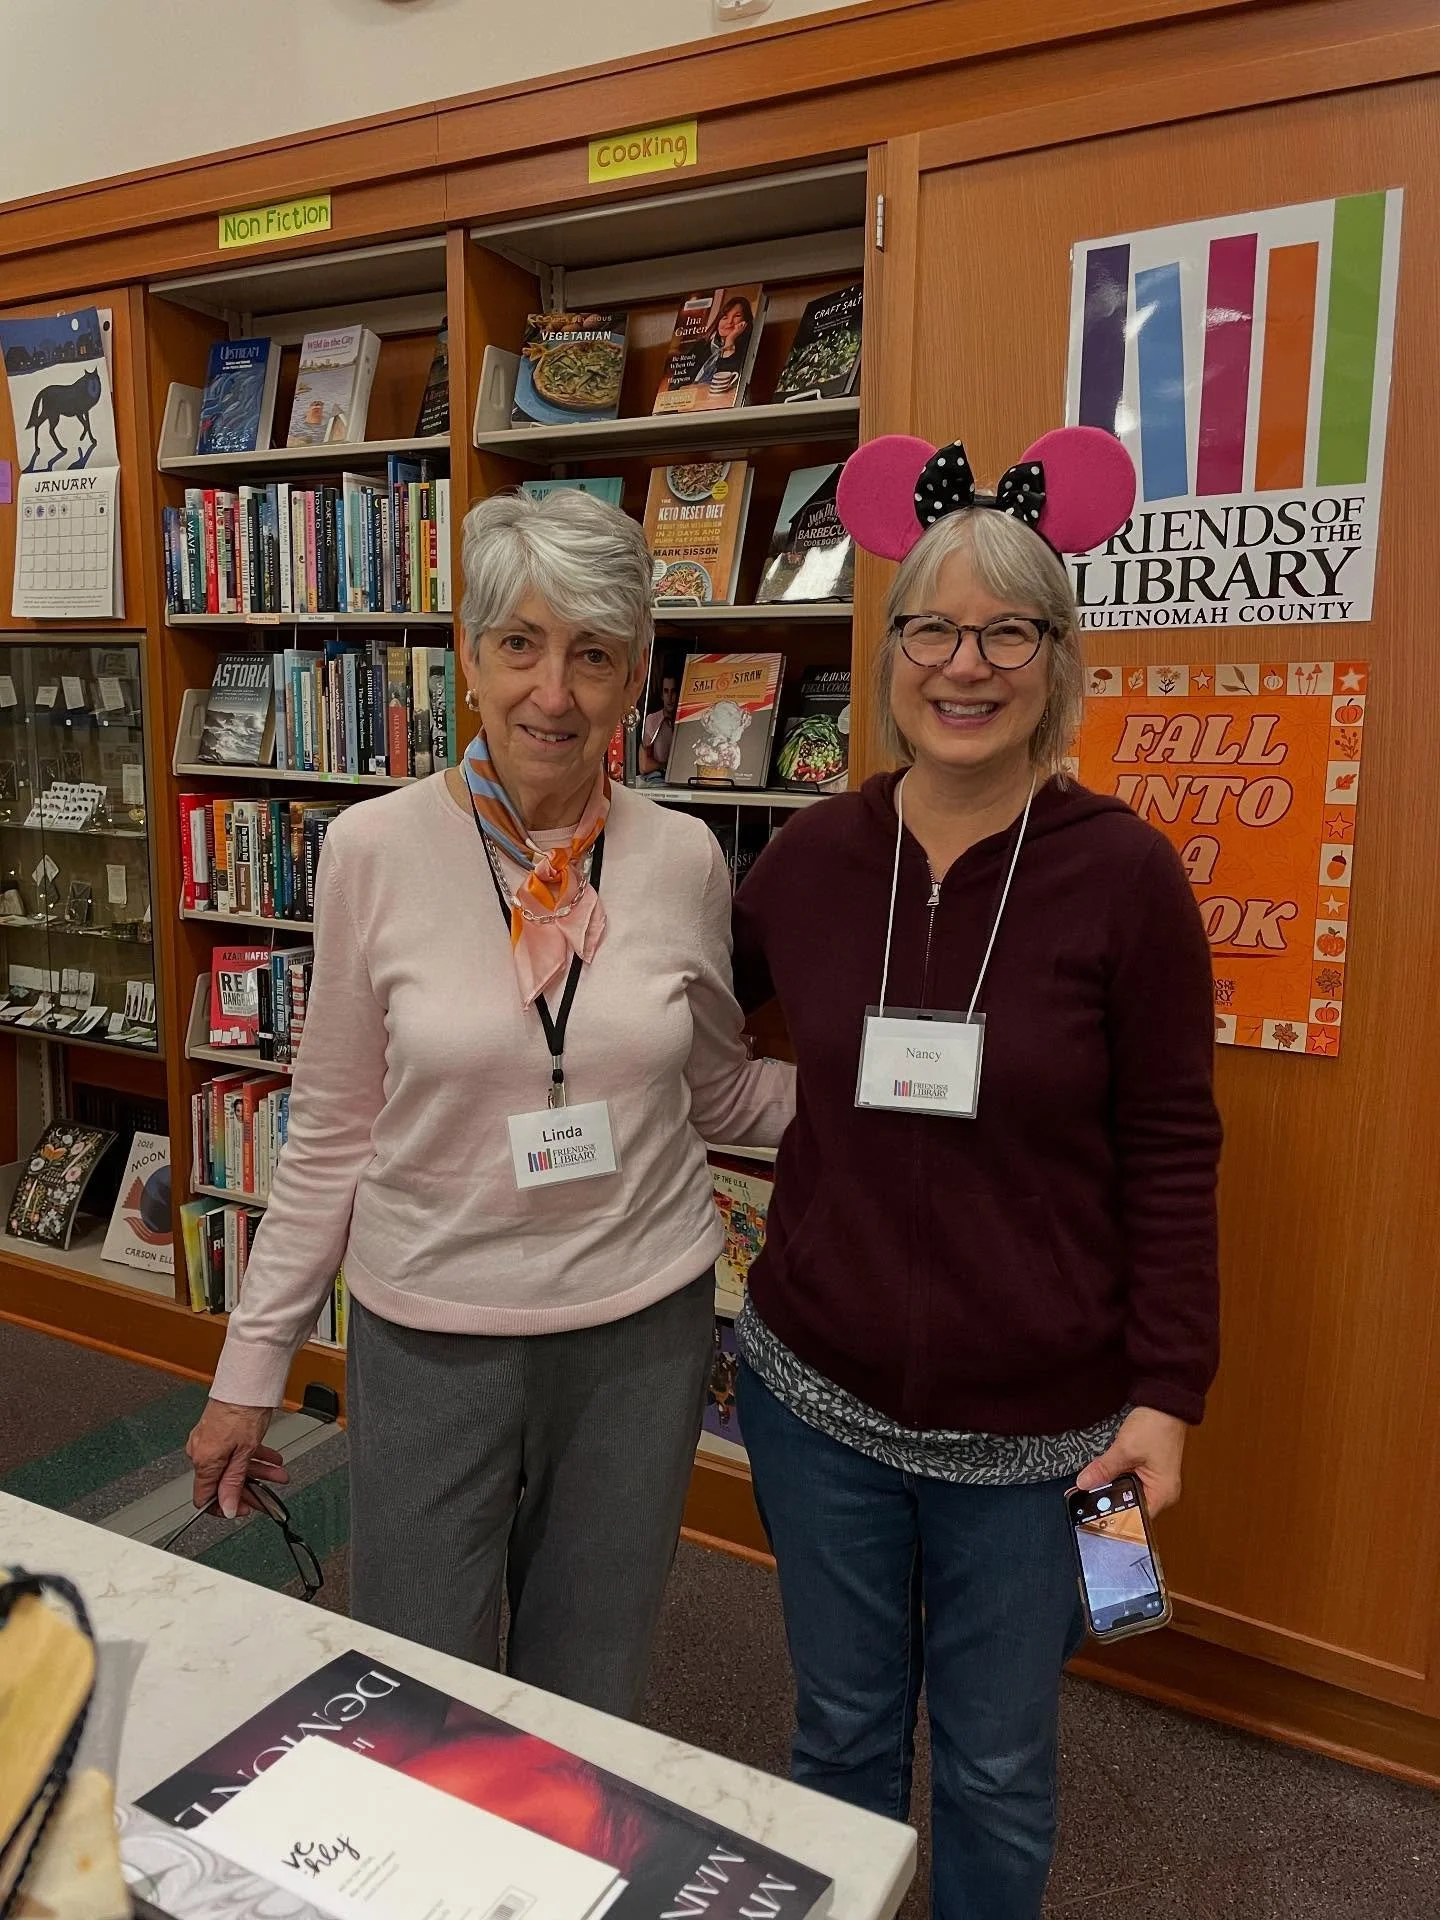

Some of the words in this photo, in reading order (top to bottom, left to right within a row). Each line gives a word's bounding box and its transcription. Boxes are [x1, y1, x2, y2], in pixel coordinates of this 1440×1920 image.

[596, 132, 688, 170] Cooking
[223, 212, 264, 242] Non
[266, 203, 330, 237] Fiction
[814, 303, 842, 320] CRAFT
[686, 316, 702, 326] Ina
[541, 331, 611, 341] VEGETARIAN
[675, 325, 709, 337] Garten
[35, 477, 98, 493] JANUARY
[658, 507, 679, 521] KETO
[680, 505, 705, 520] RESET
[705, 504, 726, 518] DIET
[315, 518, 322, 529] to
[702, 528, 721, 536] AND
[1074, 500, 1306, 558] RIENDS
[1311, 496, 1365, 524] OF
[187, 520, 196, 555] WAVE
[375, 527, 381, 538] We
[1311, 523, 1363, 544] THE
[653, 548, 681, 557] MARK
[683, 546, 719, 556] SISSON
[1072, 546, 1361, 607] LIBRARY
[1077, 606, 1228, 629] MULTNOMAH
[1238, 601, 1354, 623] COUNTY
[211, 664, 271, 688] ASTORIA
[693, 680, 714, 693] SALT
[733, 669, 763, 684] STRAW
[821, 672, 850, 682] RAWSO
[1112, 713, 1289, 766] FALL
[1114, 774, 1294, 828] INTO
[1182, 834, 1221, 885] A
[1204, 895, 1299, 951] OK
[220, 972, 257, 993] REA
[276, 979, 284, 995] BATTLE
[906, 1047, 942, 1063] Nancy
[913, 1089, 947, 1097] LIBRARY
[542, 1125, 583, 1143] Linda
[137, 1139, 154, 1150] 2026
[553, 1145, 589, 1158] FRIENDS
[131, 1150, 167, 1173] MOON
[553, 1151, 596, 1166] LIBRARY
[721, 1175, 732, 1185] THE
[125, 1247, 158, 1261] CARSON
[159, 1254, 174, 1265] ELL
